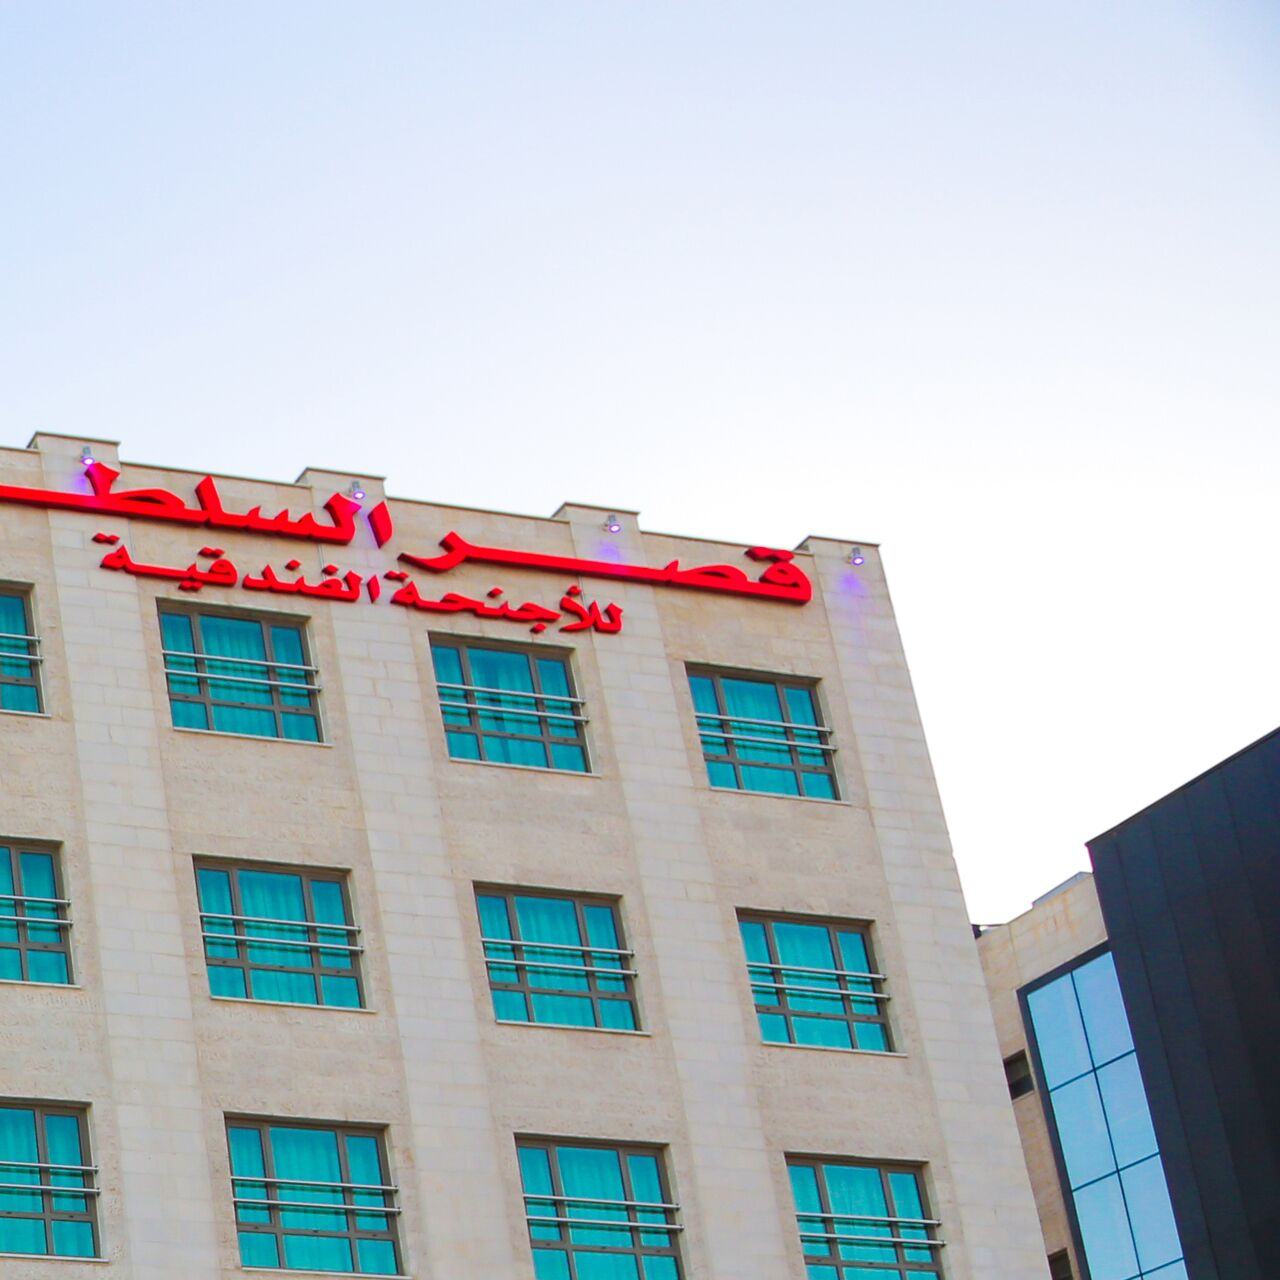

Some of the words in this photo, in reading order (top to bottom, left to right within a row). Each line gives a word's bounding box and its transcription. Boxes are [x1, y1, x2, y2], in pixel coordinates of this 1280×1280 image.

[92, 532, 382, 604] الفندقية
[386, 569, 624, 635] للأجنحة
[397, 530, 814, 604] قصر
